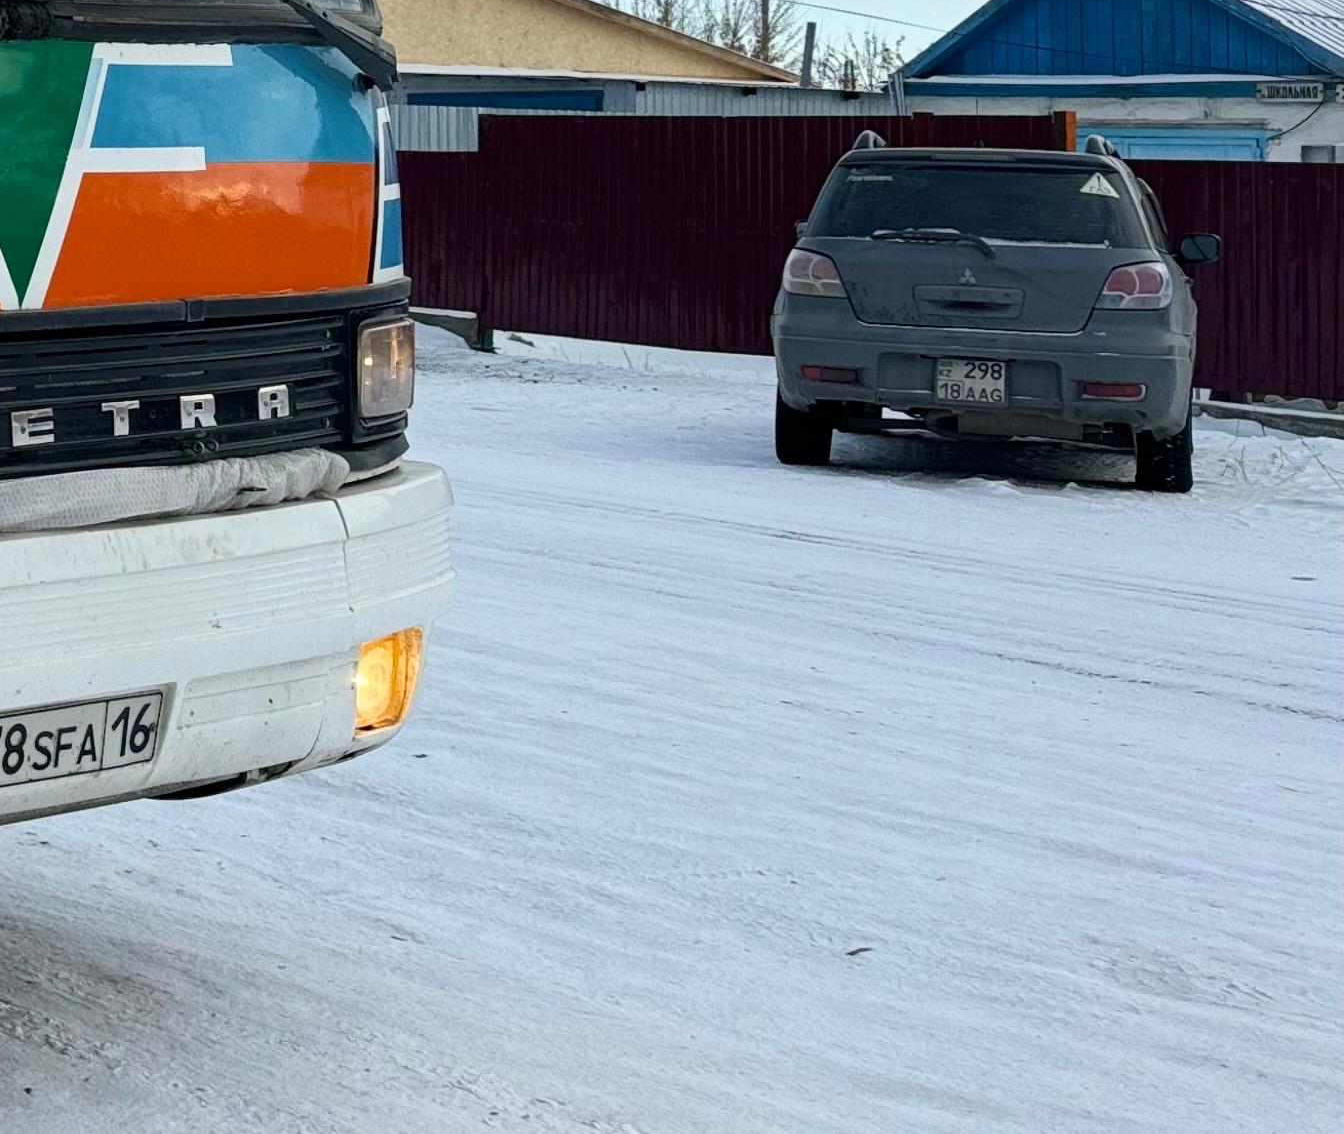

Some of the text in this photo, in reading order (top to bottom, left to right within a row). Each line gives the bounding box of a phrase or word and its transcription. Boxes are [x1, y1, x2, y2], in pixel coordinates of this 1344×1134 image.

[1267, 85, 1318, 99] ШКОЛЬНАЯ
[964, 361, 1003, 381] 298
[940, 382, 1003, 402] 18 AAG
[111, 702, 152, 758] 16
